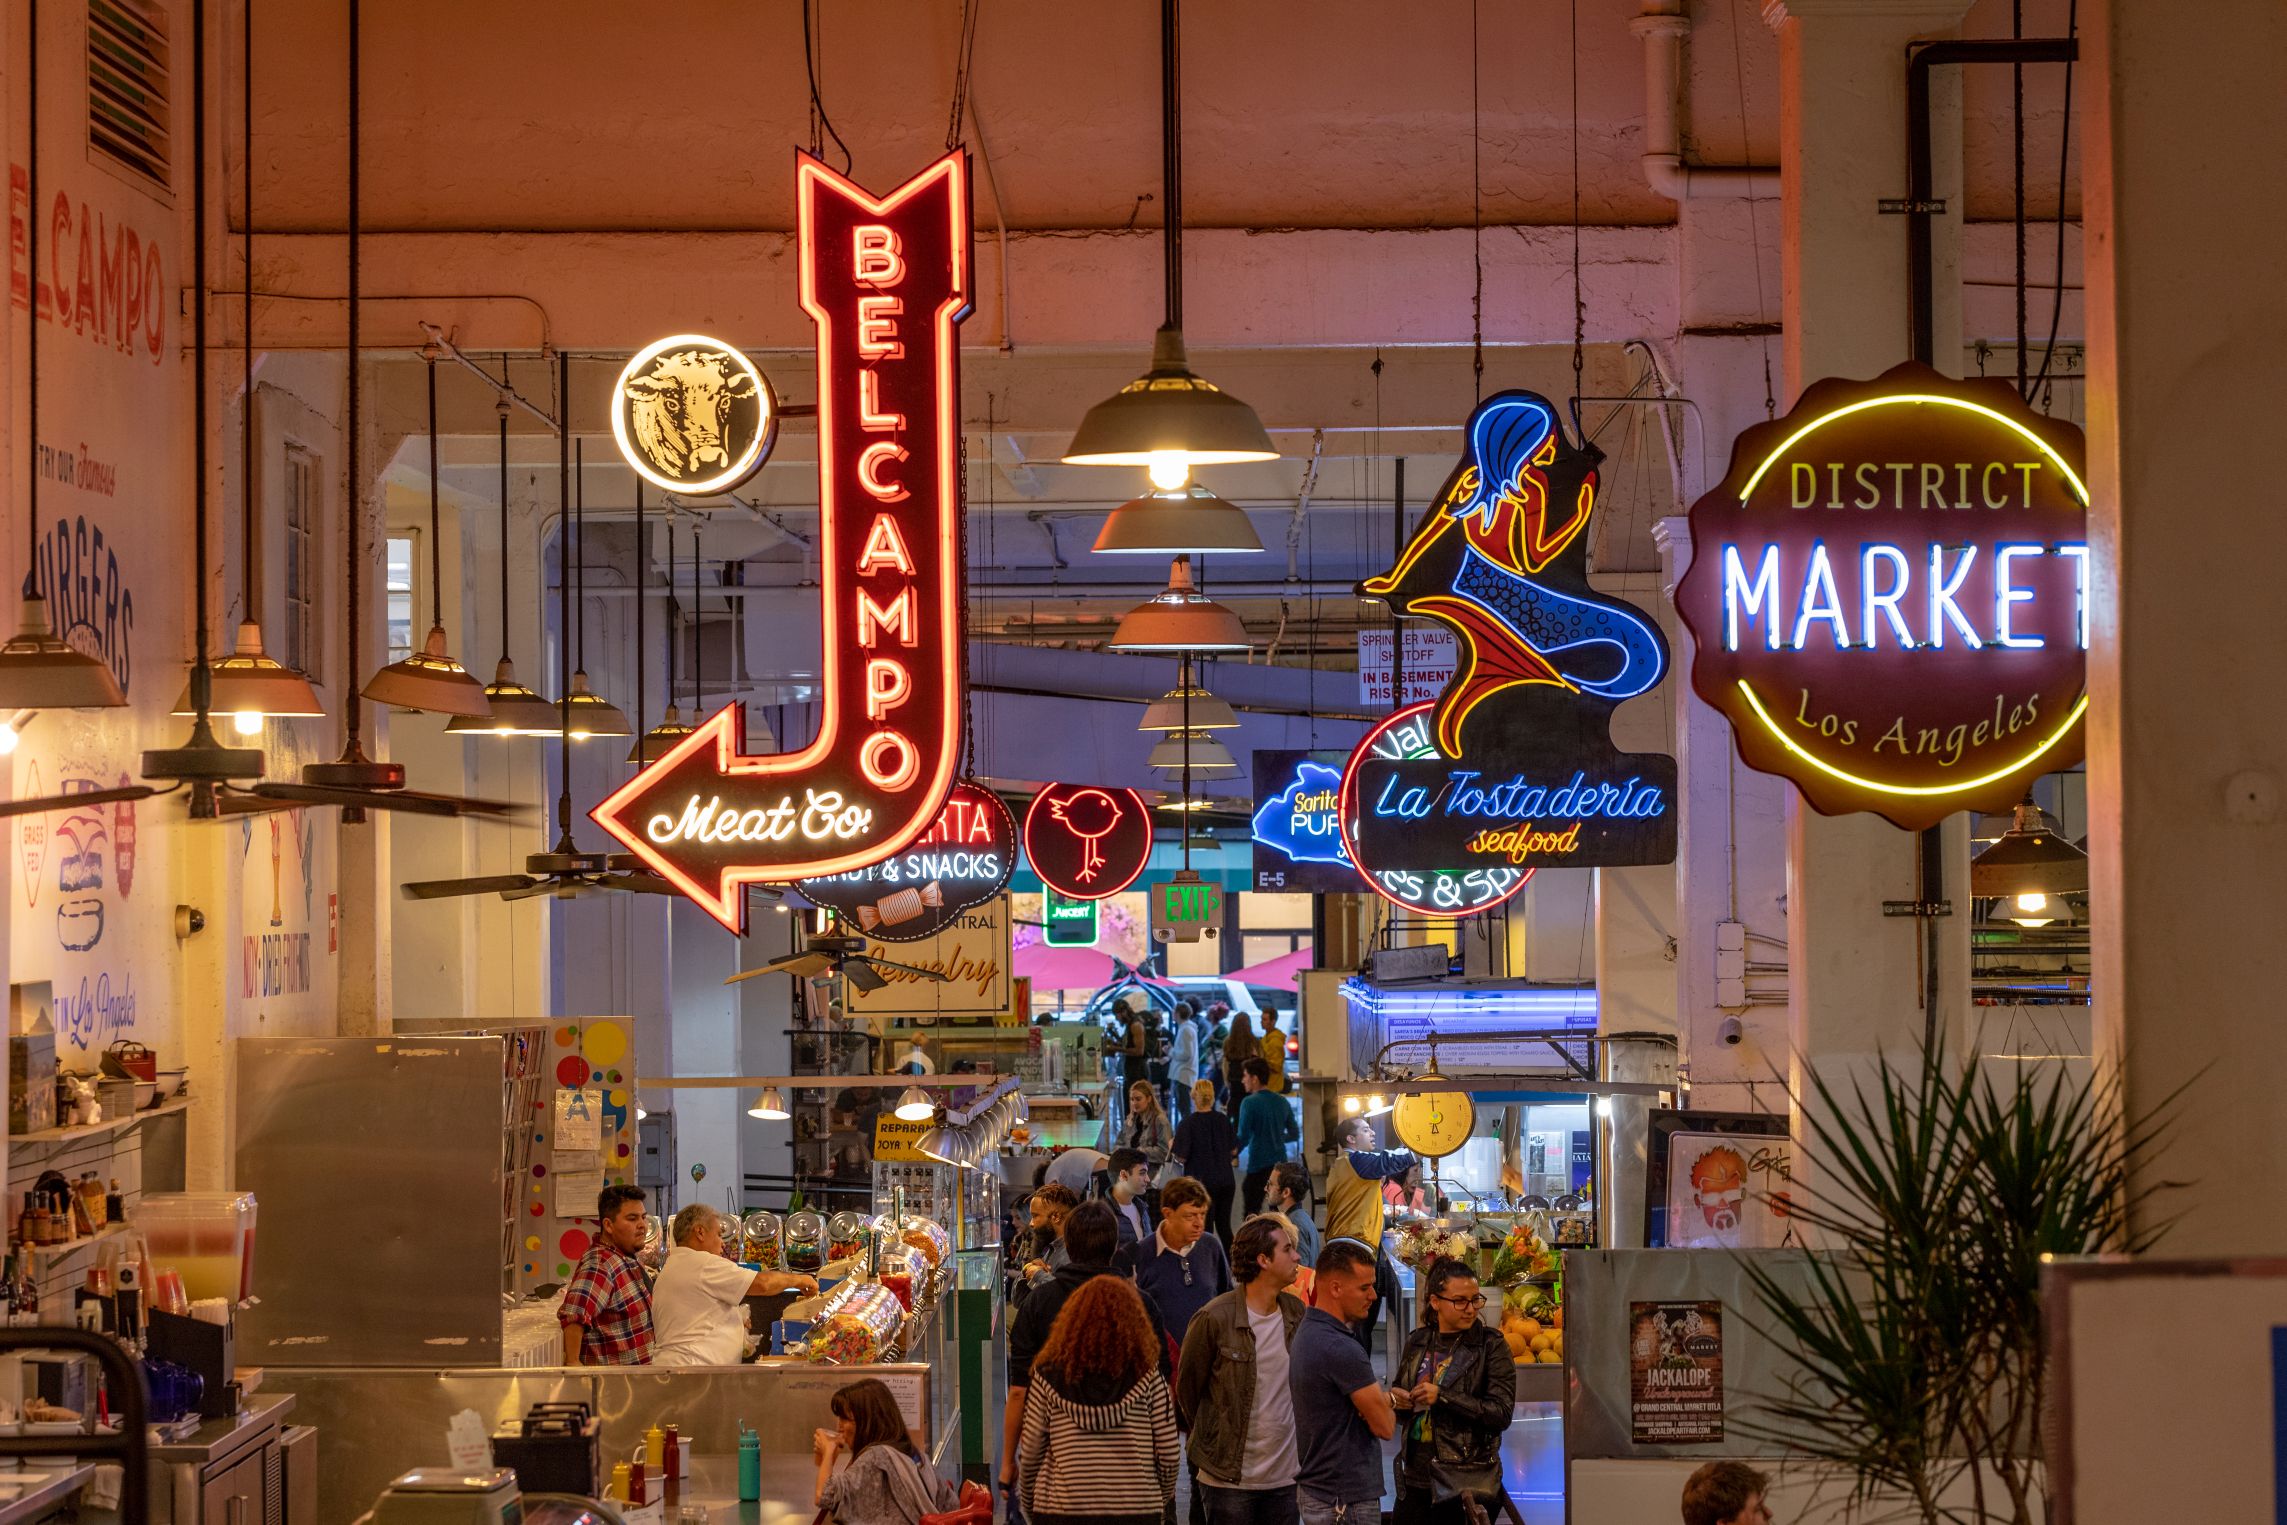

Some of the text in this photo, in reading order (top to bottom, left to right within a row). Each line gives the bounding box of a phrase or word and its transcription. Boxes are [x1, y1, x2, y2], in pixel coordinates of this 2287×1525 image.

[38, 444, 56, 481] TRY
[58, 450, 75, 486] OUR
[1791, 462, 2041, 510] DISTRICT
[853, 225, 921, 793] BELCAMPO
[1721, 539, 2089, 652] MARKET
[1362, 633, 1453, 647] SPRINLER VALVE
[1381, 649, 1434, 662] SHTOFF
[1363, 672, 1377, 684] IN
[1370, 686, 1435, 700] RISR No.
[1795, 687, 2040, 767] Los Angeles
[1374, 768, 1666, 819] La Tostadería
[24, 826, 44, 845] GRASS
[648, 795, 796, 843] Meat
[918, 801, 992, 843] RTA
[1466, 822, 1582, 865] seafood
[905, 853, 999, 880] SNACKS
[1259, 872, 1285, 887] E-5
[1165, 886, 1213, 922] EXIT
[1432, 875, 1464, 907] &
[262, 934, 282, 997] DRIED
[565, 1093, 591, 1122] A
[1647, 1368, 1712, 1386] JACKALOPE
[1641, 1403, 1660, 1412] GRAND
[1660, 1403, 1684, 1412] CENTRAL
[1684, 1402, 1707, 1411] MARKET
